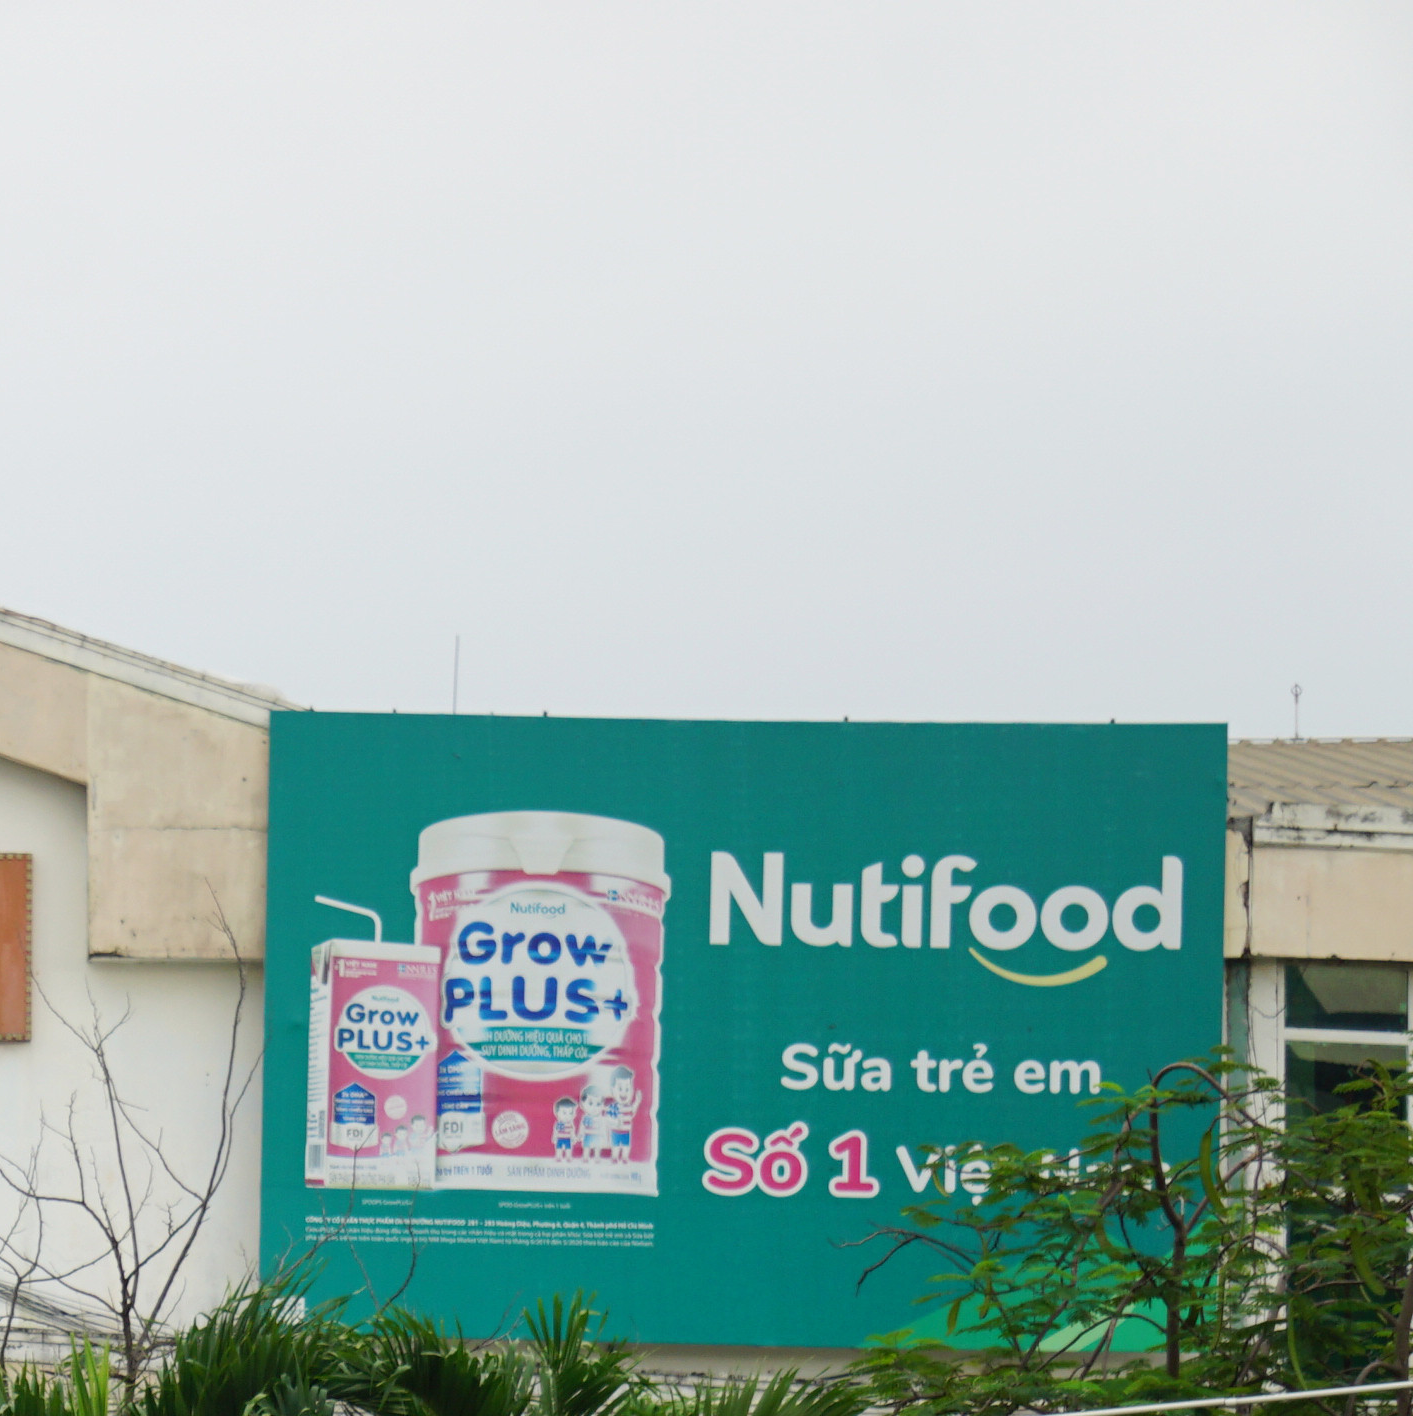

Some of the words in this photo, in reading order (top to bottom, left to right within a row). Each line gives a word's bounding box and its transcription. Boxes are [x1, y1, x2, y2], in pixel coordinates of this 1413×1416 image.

[509, 901, 566, 919] Nutifood
[710, 849, 1184, 952] Nutifood
[457, 921, 613, 967] Grow
[345, 1003, 420, 1028] Grow
[444, 975, 629, 1025] PLUS+
[337, 1028, 430, 1053] PLUS+
[779, 1042, 892, 1092] Sữa
[909, 1043, 994, 1093] trẻ
[1013, 1059, 1101, 1095] em
[703, 1121, 810, 1198] Số
[829, 1128, 880, 1198] 1
[895, 1144, 1011, 1207] Việ
